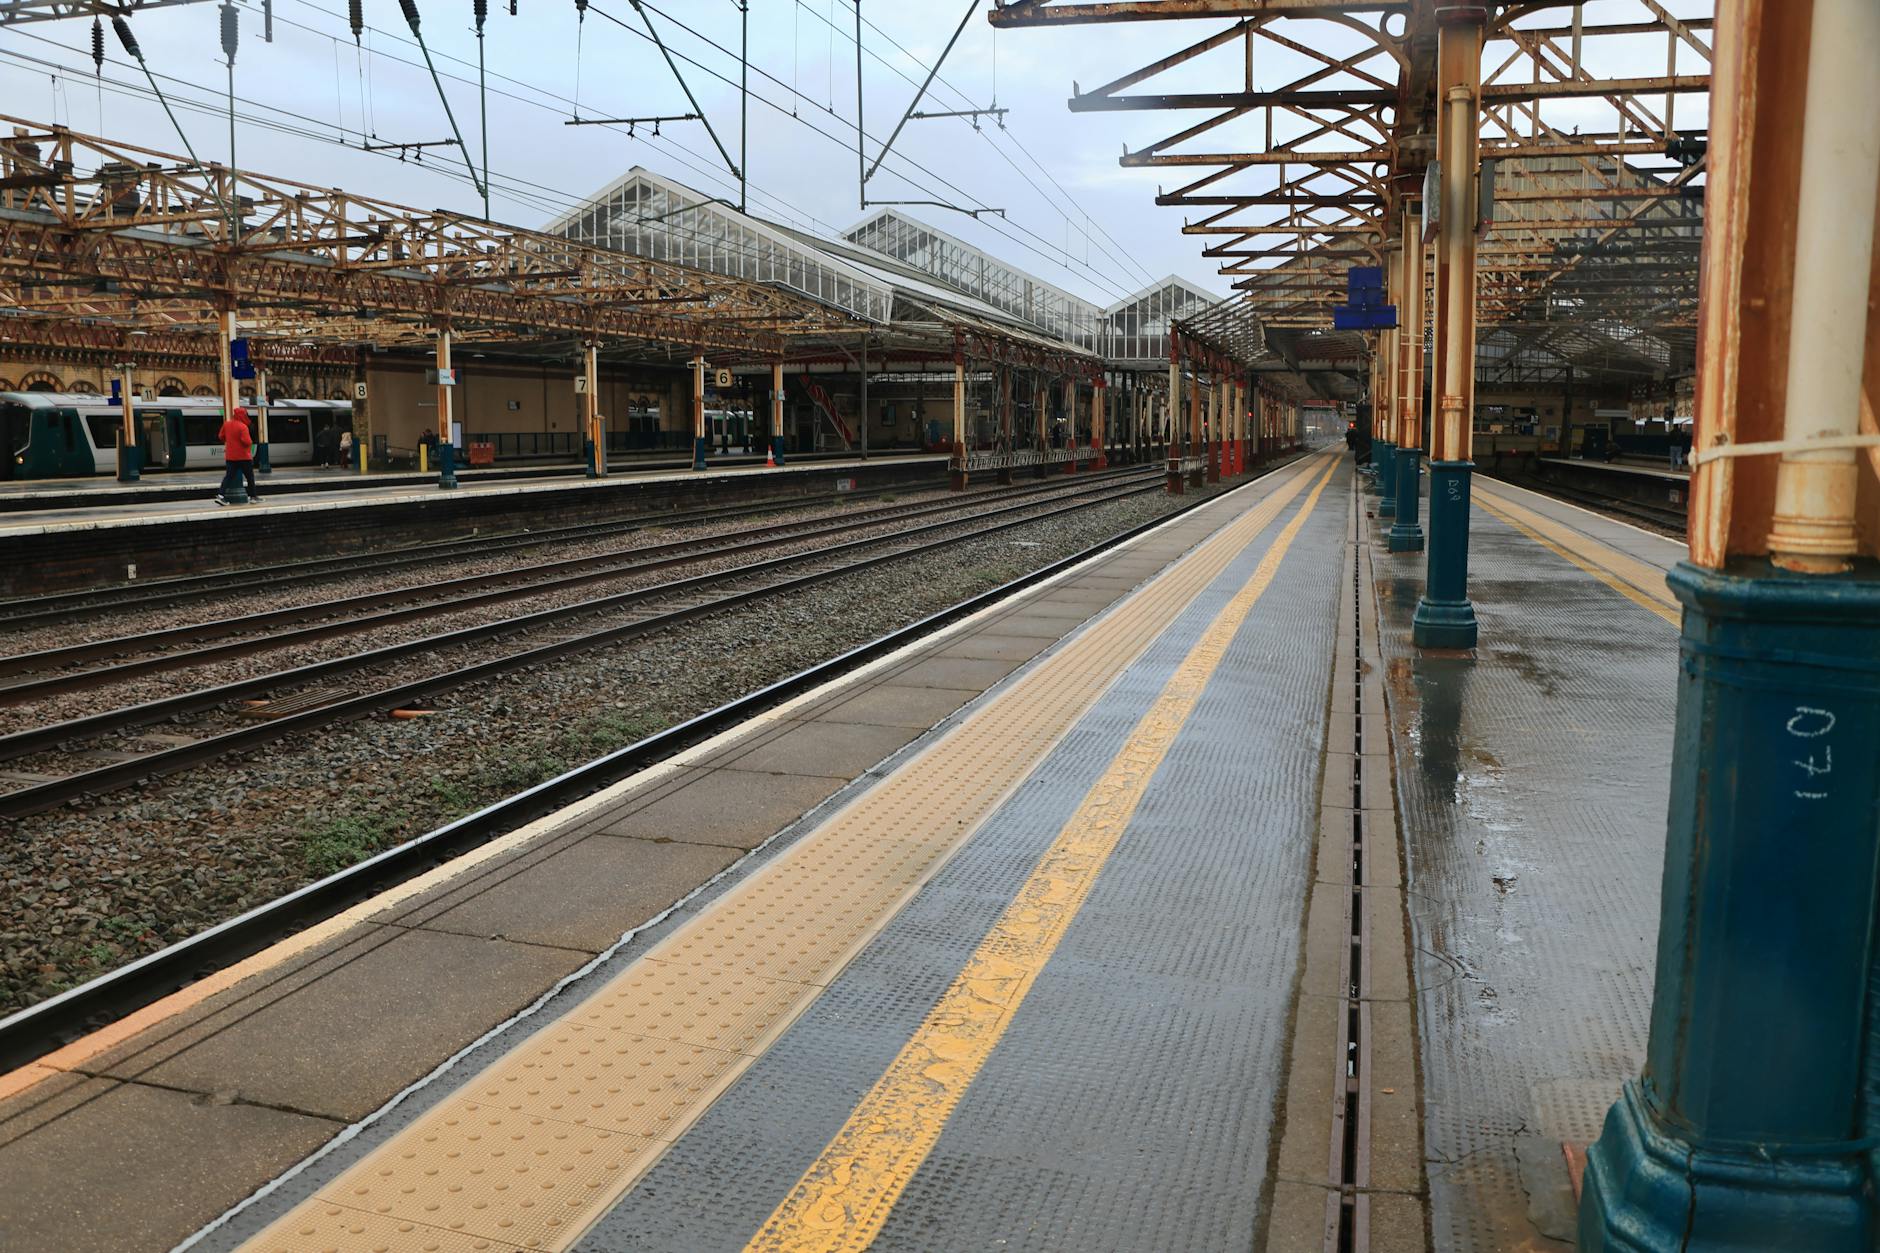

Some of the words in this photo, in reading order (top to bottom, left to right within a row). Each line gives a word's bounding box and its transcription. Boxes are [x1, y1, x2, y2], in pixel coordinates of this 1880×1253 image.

[720, 373, 728, 384] 6
[578, 380, 586, 391] 7
[145, 390, 153, 400] 11
[358, 386, 366, 397] 8
